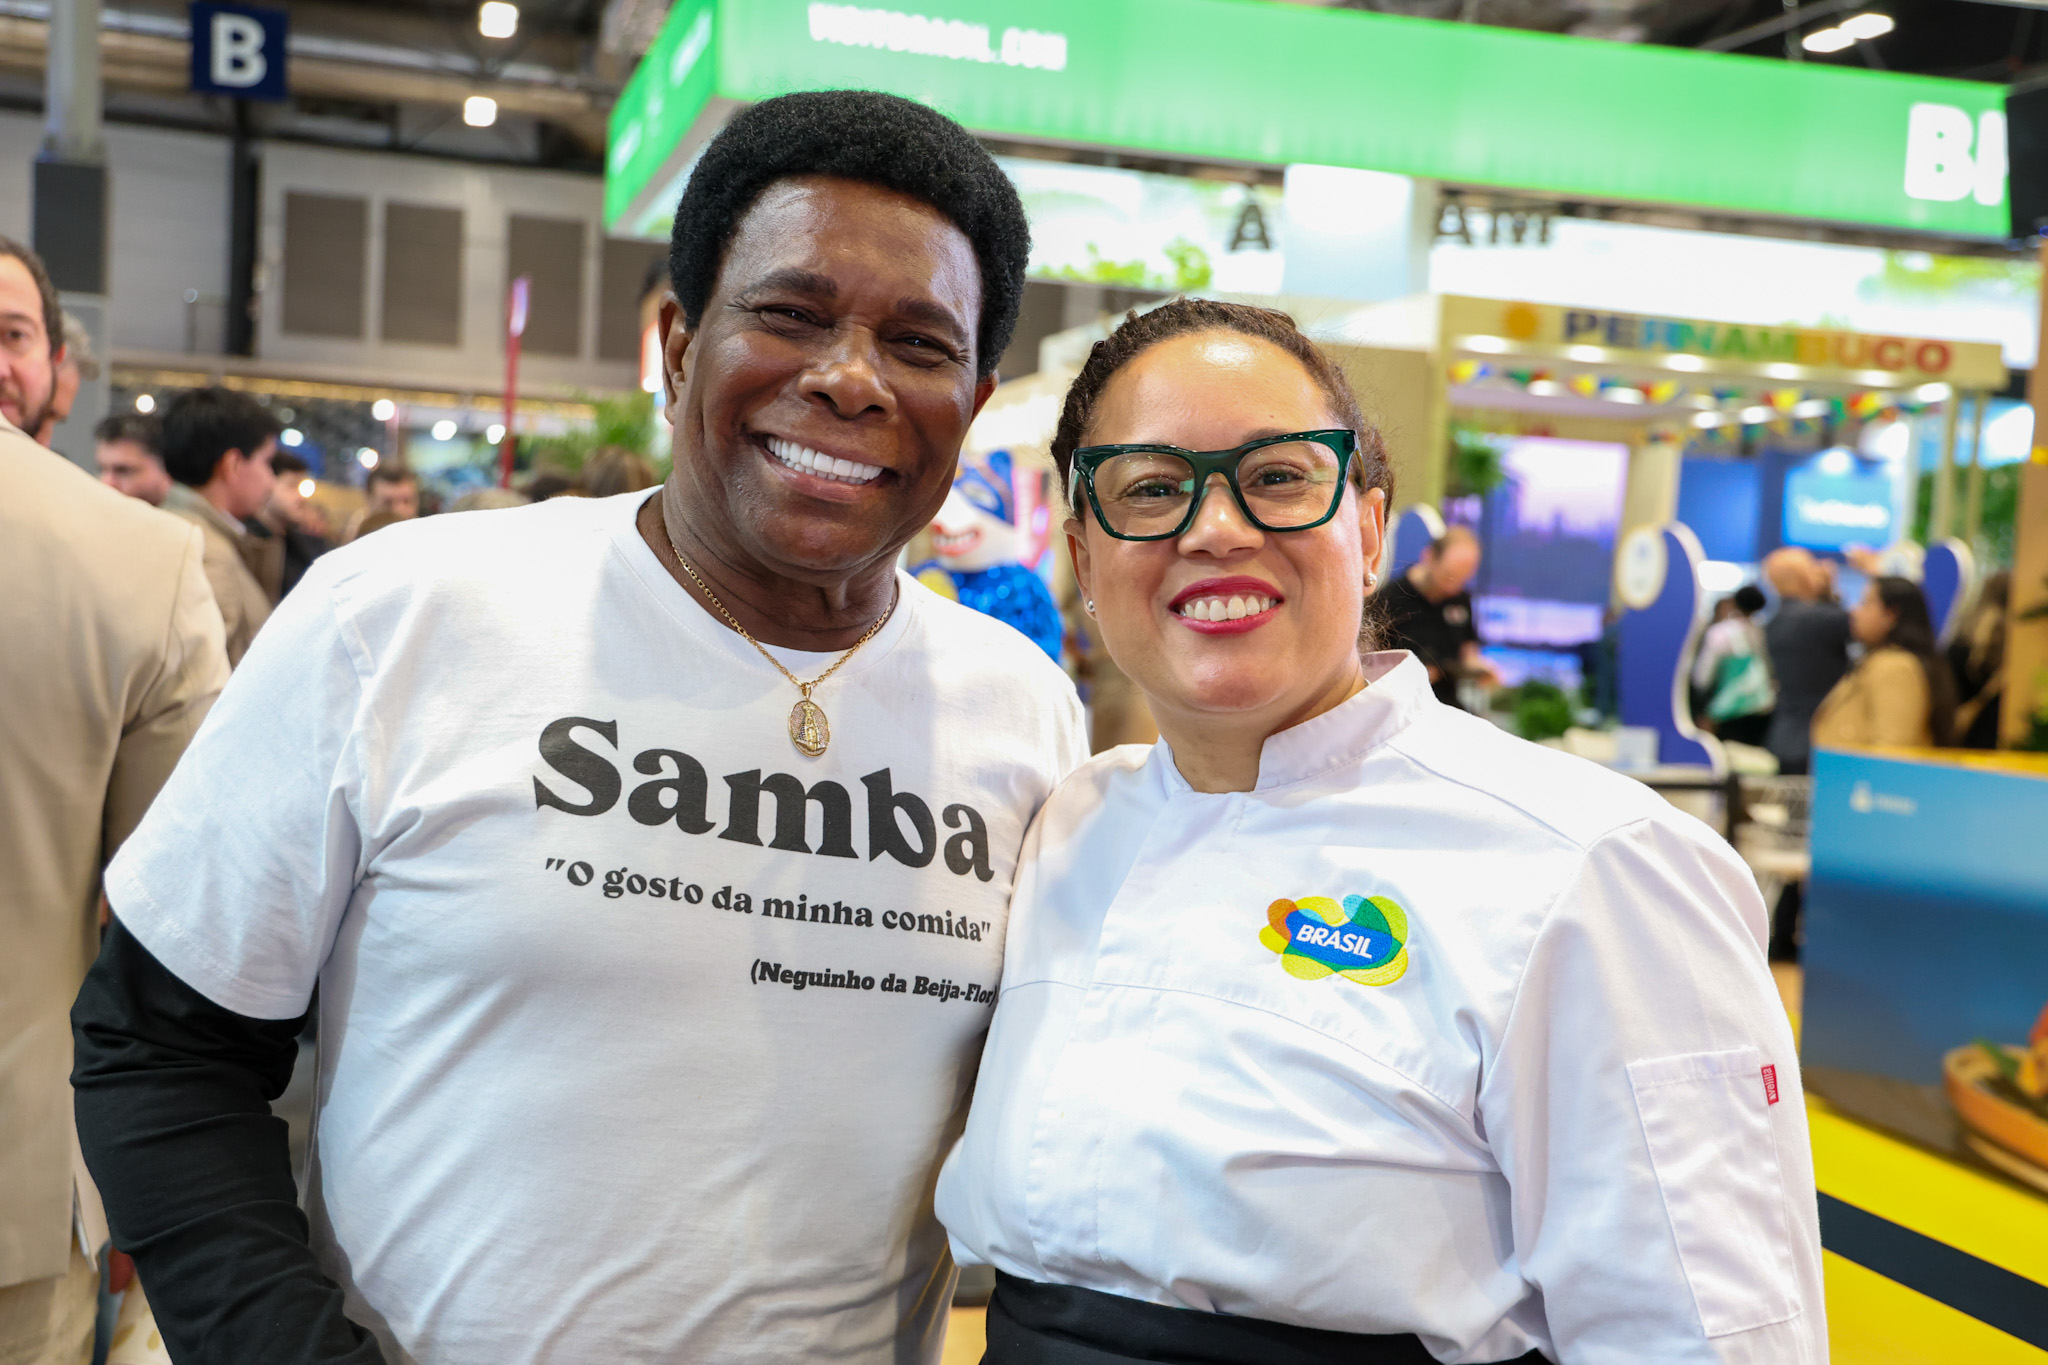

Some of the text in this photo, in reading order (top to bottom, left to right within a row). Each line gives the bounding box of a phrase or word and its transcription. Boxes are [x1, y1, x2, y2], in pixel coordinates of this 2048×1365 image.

[210, 12, 268, 88] B
[1566, 311, 1952, 375] PERNAMBUCO
[532, 716, 995, 883] Samba
[602, 867, 704, 905] gosto
[711, 885, 754, 914] da
[761, 894, 874, 927] minha
[882, 909, 991, 942] comida"
[1296, 924, 1372, 959] BRASIL
[751, 959, 998, 1007] (Neguinho da Beija-Flor)
